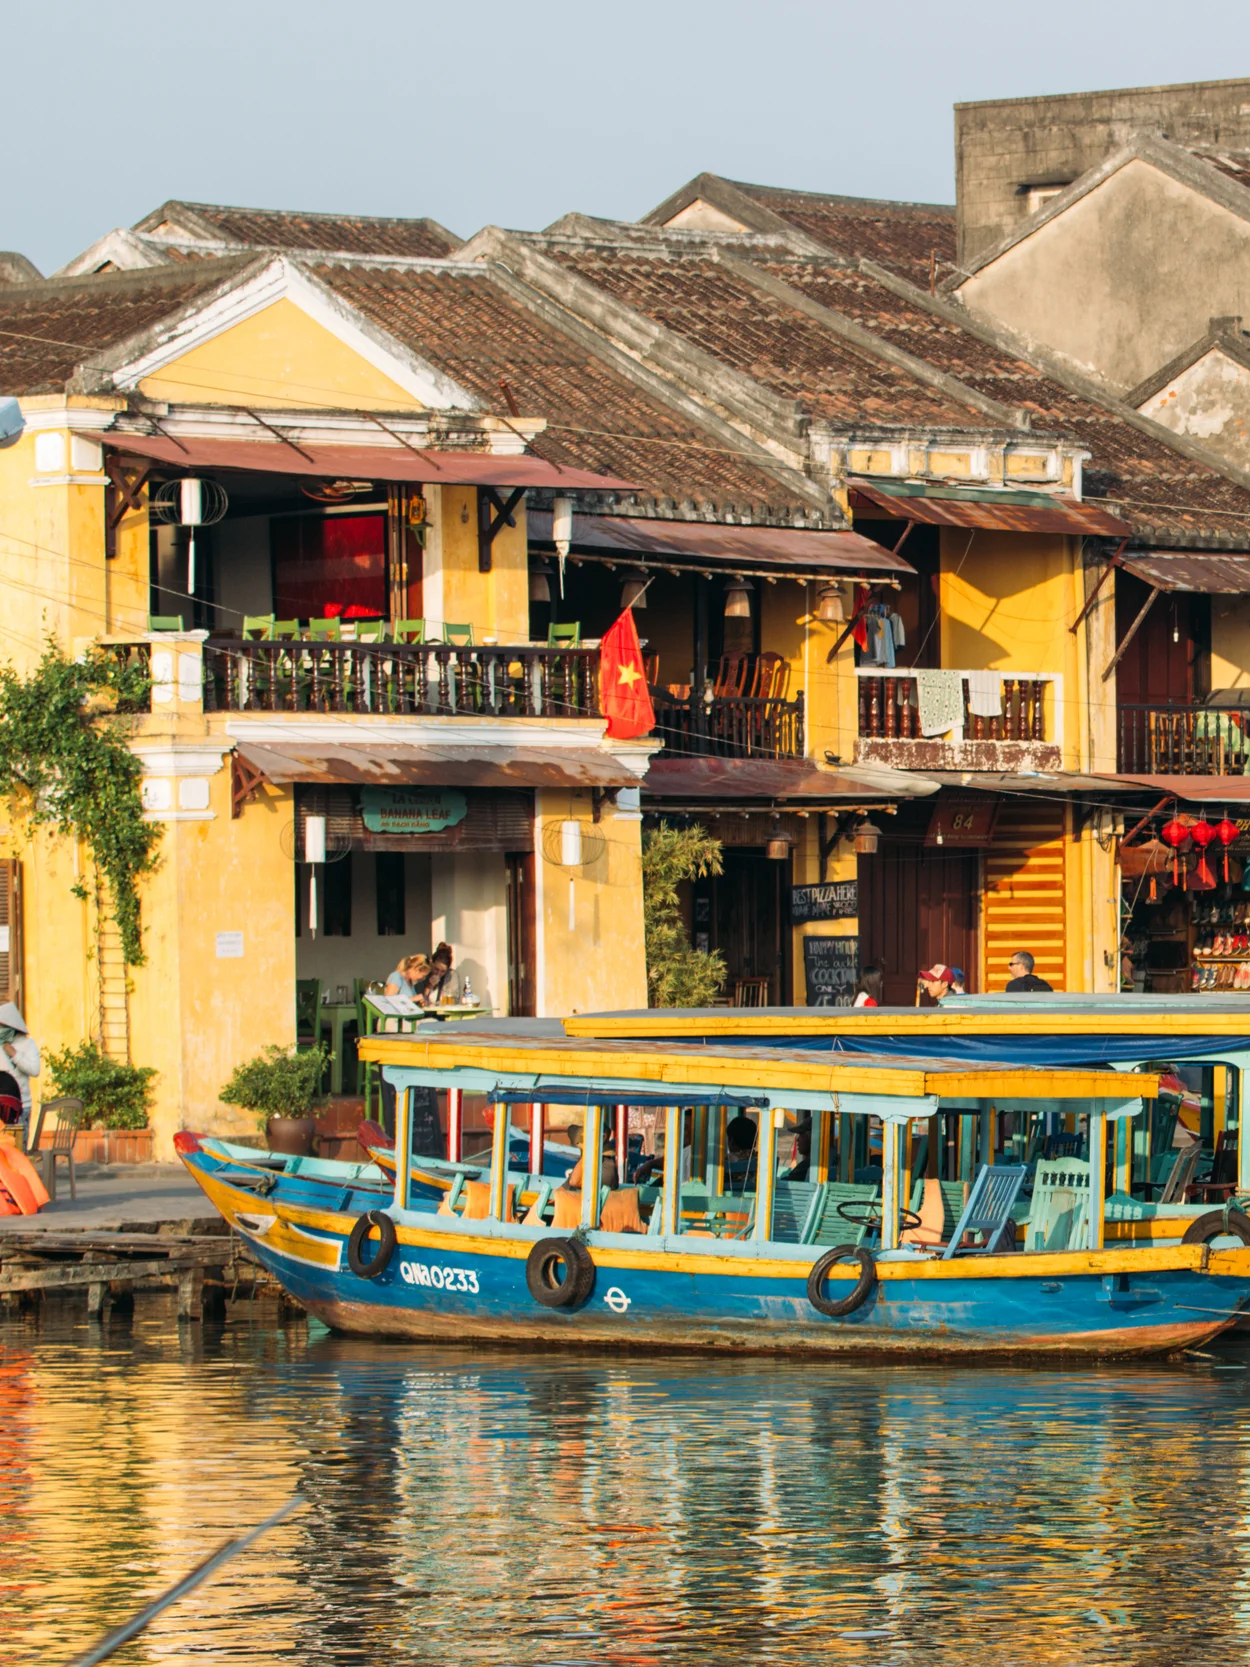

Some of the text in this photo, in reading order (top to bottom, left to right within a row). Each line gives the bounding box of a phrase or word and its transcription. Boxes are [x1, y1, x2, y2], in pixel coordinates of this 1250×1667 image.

[380, 807, 451, 820] BANANA LEAF
[953, 814, 974, 830] 84
[792, 884, 858, 905] BEST PIZZA HERE
[808, 955, 830, 967] The
[815, 984, 847, 993] ONLY
